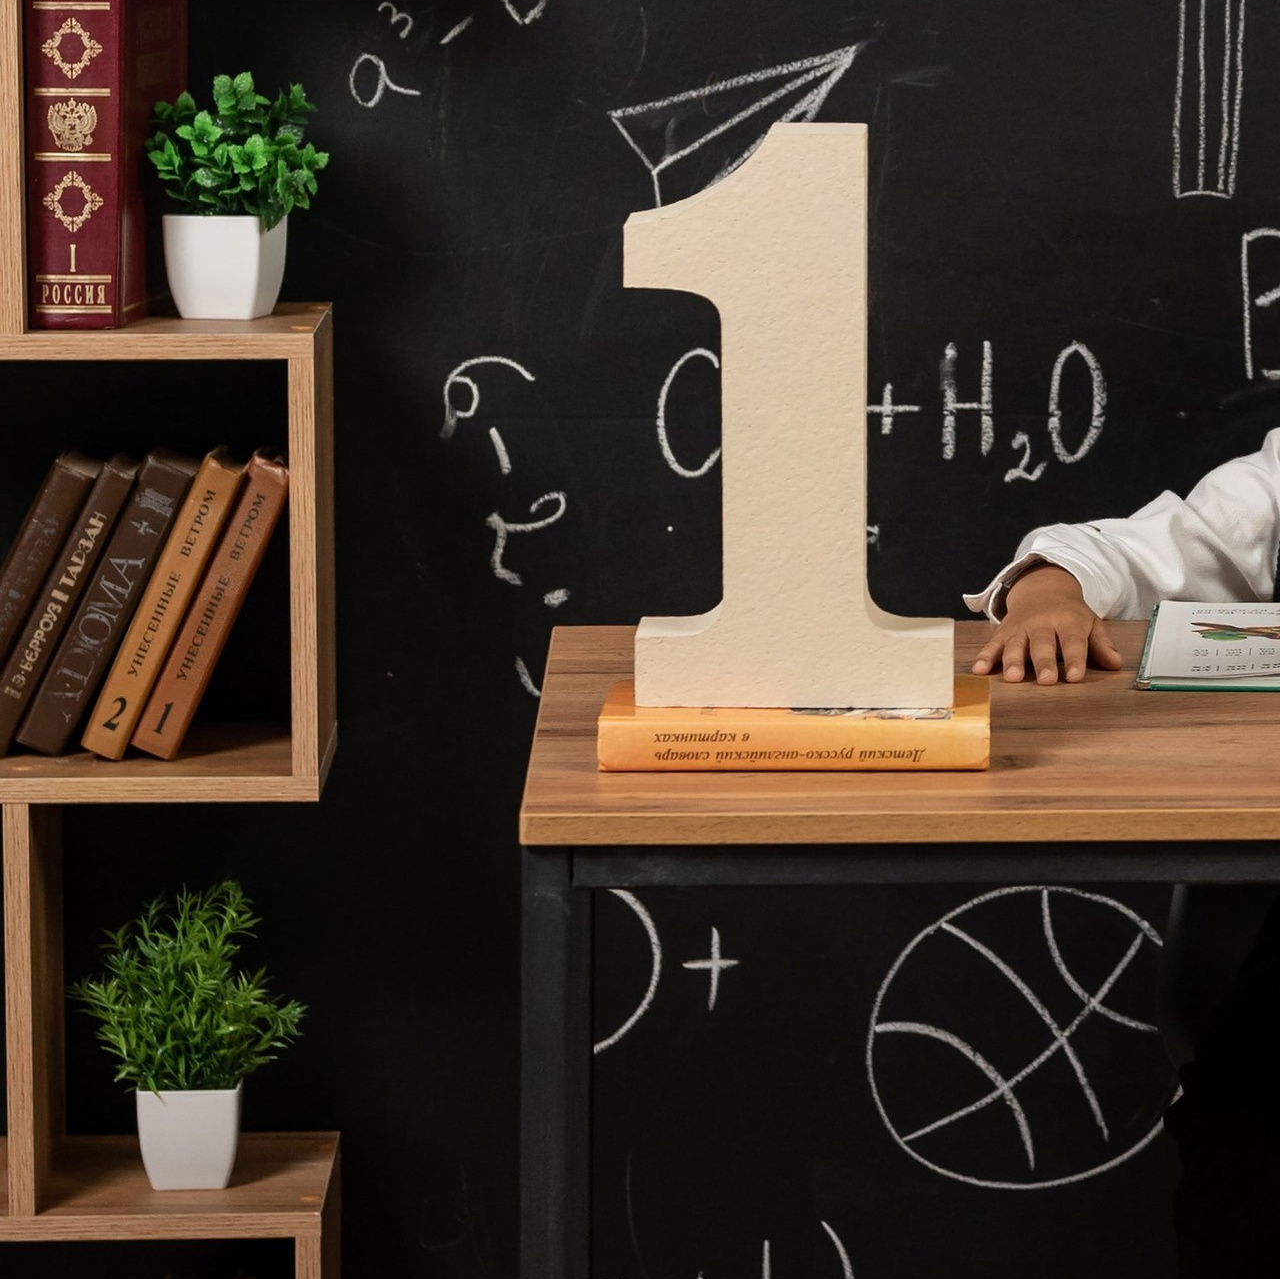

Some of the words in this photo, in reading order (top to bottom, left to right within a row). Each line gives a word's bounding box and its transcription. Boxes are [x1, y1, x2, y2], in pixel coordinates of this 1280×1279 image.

[41, 284, 106, 305] РОССИЯ
[102, 696, 128, 732] 2
[127, 572, 181, 677] УНЕСЕННЫЕ
[180, 489, 216, 558] ВЕТРОМ
[152, 701, 174, 735] 1
[176, 575, 230, 681] УНЕСЕННЫЕ
[229, 493, 266, 562] ВЕТРОМ
[654, 732, 735, 744] картинках
[654, 748, 710, 763] словарь
[715, 748, 854, 764] русско-английский
[859, 749, 926, 765] Детский
